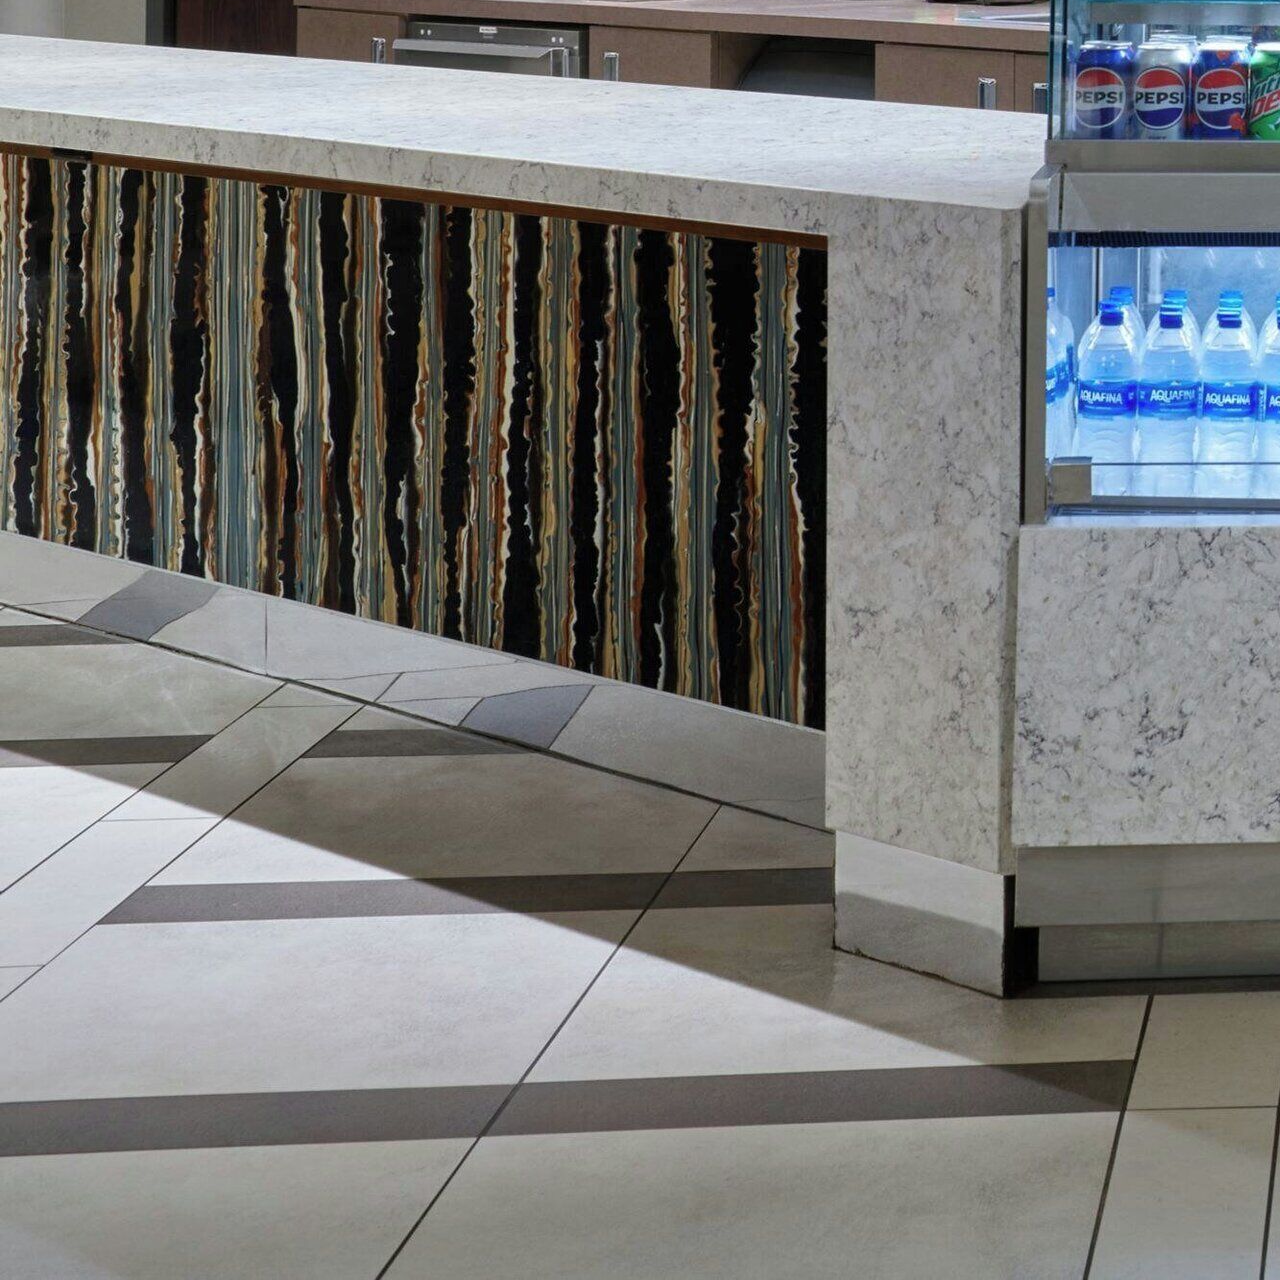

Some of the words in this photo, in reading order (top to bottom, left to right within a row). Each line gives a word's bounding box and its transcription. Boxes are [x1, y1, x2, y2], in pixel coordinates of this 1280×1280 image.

[1076, 91, 1123, 104] PEPSI
[1136, 91, 1184, 105] PEPSI
[1197, 92, 1246, 105] PEPSI
[1205, 393, 1251, 406] AQUAFINA
